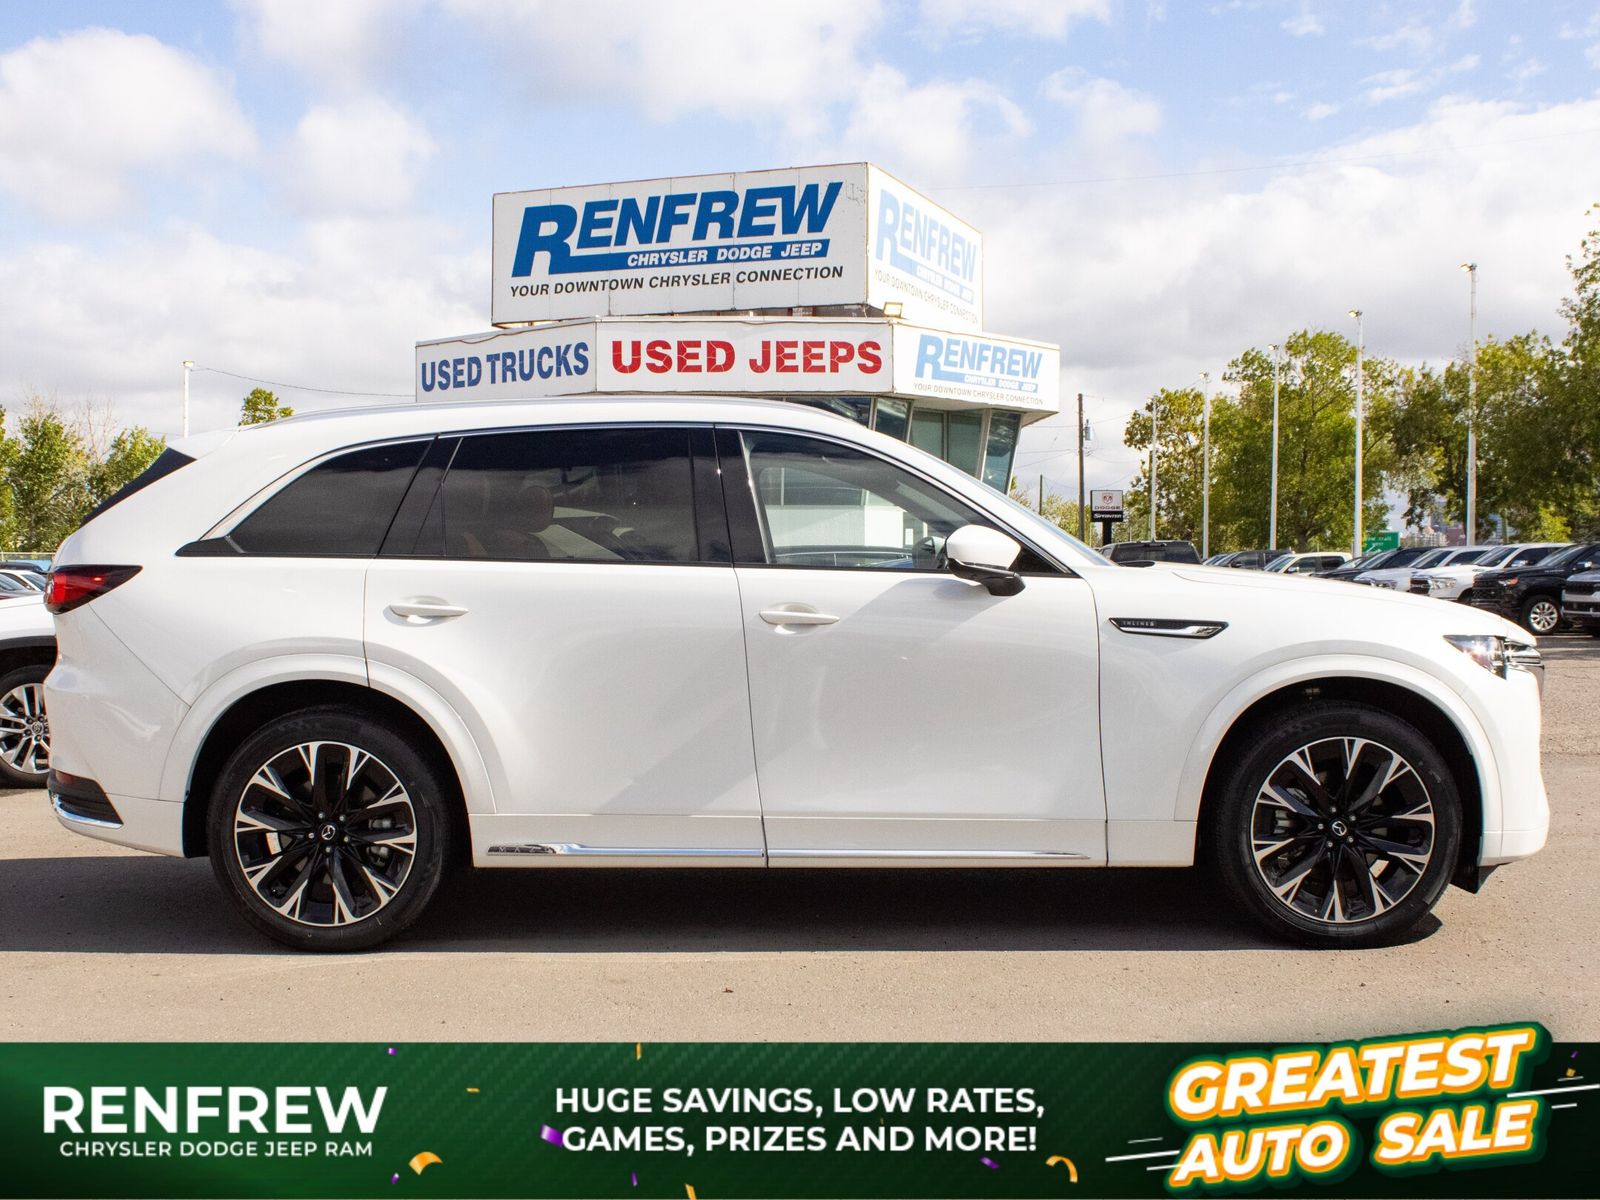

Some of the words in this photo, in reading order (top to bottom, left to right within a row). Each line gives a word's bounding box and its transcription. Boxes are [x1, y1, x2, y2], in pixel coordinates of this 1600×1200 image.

[511, 181, 843, 277] RENFREW
[875, 189, 977, 283] RENFREW
[627, 248, 708, 267] CHRYSLER
[716, 245, 772, 261] DODGE
[780, 242, 823, 257] JEEP
[510, 284, 550, 298] YOUR
[554, 277, 644, 294] DOWNTOWN
[649, 271, 731, 288] CHRYSLER
[736, 265, 844, 283] CONNECTION
[421, 356, 482, 392] USED
[486, 342, 589, 384] TRUCKS
[611, 339, 736, 374] USED
[748, 340, 882, 374] JEEPS
[914, 334, 1043, 379] RENFREW
[914, 382, 932, 391] YOUR
[933, 384, 972, 397] DOWNTOWN
[973, 390, 1004, 400] CHRYSLER
